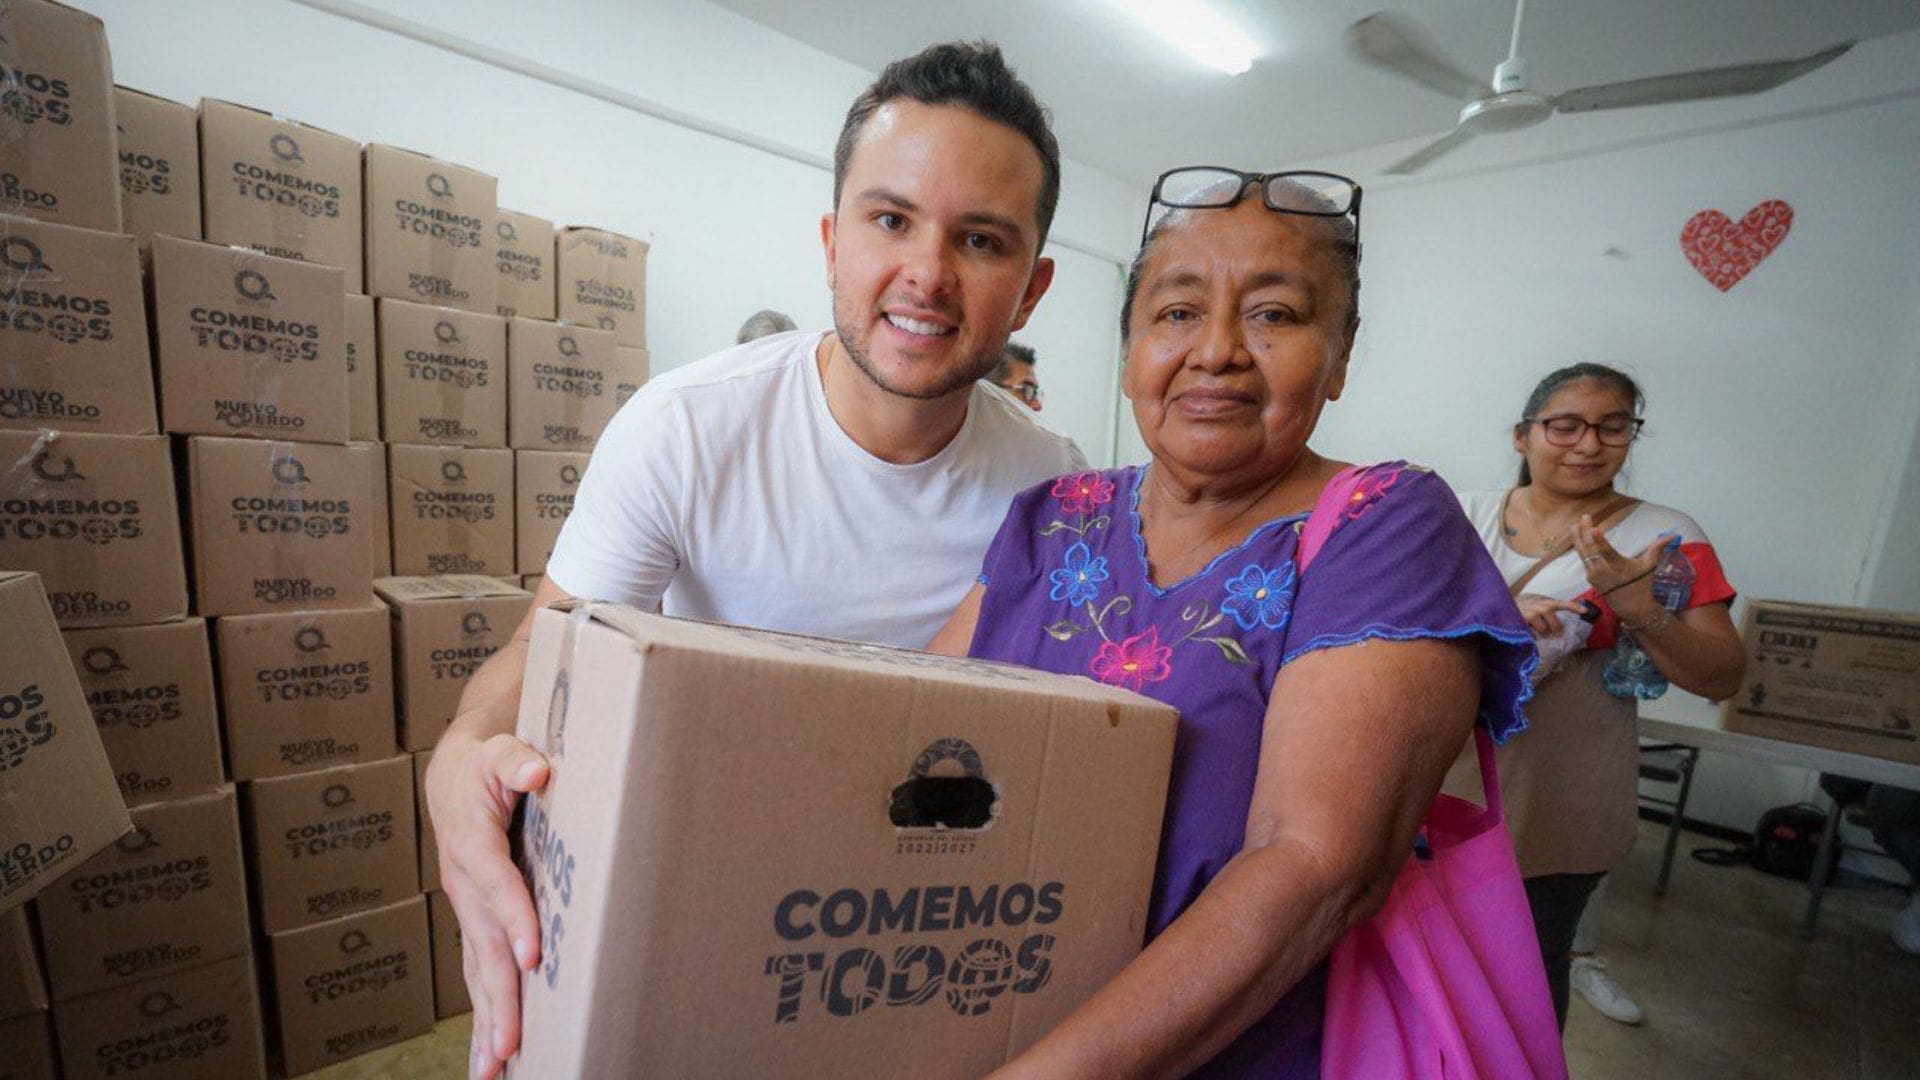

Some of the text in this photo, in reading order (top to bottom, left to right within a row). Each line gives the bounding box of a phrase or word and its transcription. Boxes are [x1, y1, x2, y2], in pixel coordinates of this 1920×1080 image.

[233, 162, 340, 199] COMEMOS
[233, 176, 341, 219] TODOS
[396, 200, 482, 231] COMEMOS
[396, 214, 481, 248] TODOS
[190, 307, 319, 339] COMEMOS
[190, 325, 319, 364] TODOS
[405, 350, 488, 370] COMEMOS
[533, 363, 603, 381] COMEMOS
[405, 363, 488, 389] TODOS
[533, 375, 603, 397] TODOS
[215, 400, 277, 416] NUEVO
[0, 500, 140, 515] OMEMOS
[232, 497, 350, 513] COMEMOS
[414, 490, 495, 504] COMEMOS
[232, 514, 350, 539] TODOS
[414, 505, 495, 523] TODOS
[254, 578, 312, 590] NUEVO
[257, 661, 370, 682] COMEMOS
[257, 675, 370, 702] TODOS
[286, 811, 392, 841] COMEMOS
[286, 825, 392, 859] TODOS
[70, 856, 209, 892] COMEMOS
[773, 881, 1065, 941] COMEMOS
[304, 951, 407, 988] COMEMOS
[764, 933, 1056, 1024] TODOS
